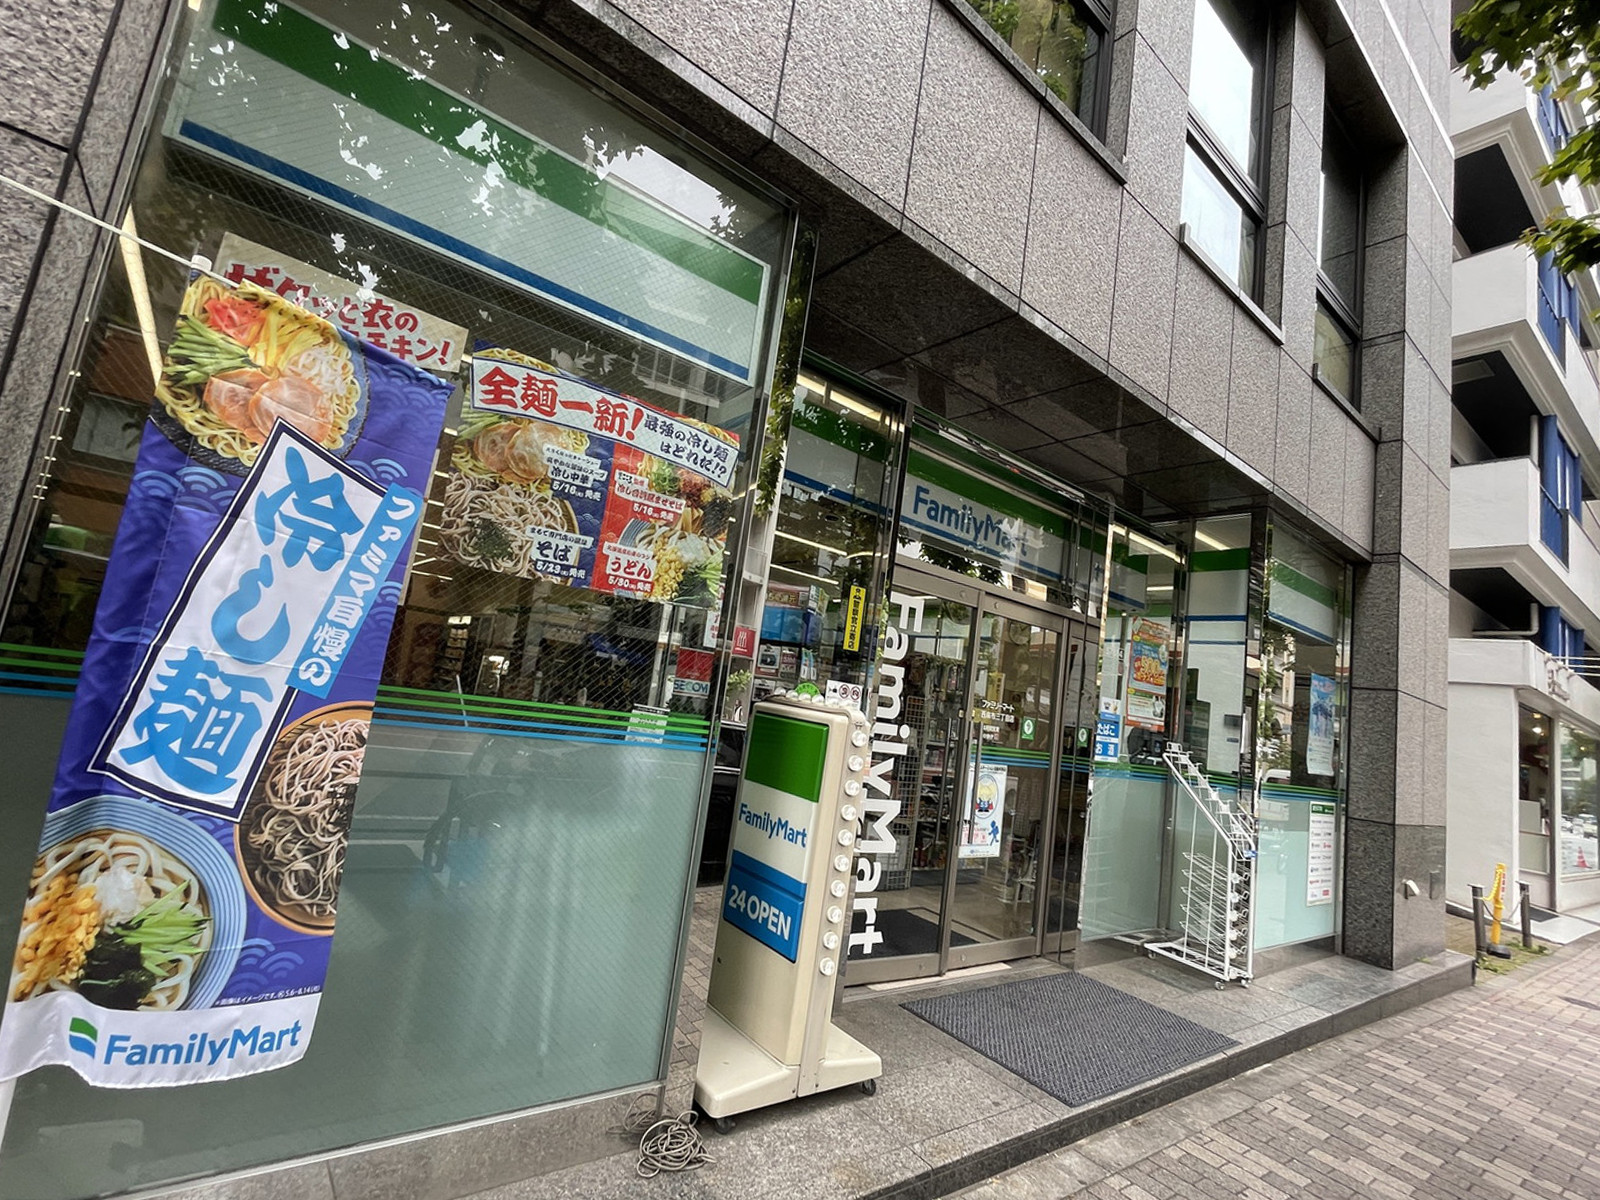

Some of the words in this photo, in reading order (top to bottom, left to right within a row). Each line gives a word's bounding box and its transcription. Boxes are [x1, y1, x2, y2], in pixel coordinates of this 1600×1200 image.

[479, 366, 643, 441] 全麺一新!
[644, 413, 729, 463] 最強の冷し麺
[912, 484, 1029, 557] FamilyMart
[536, 540, 573, 563] そば
[611, 557, 652, 579] うどん
[298, 495, 416, 687] ファミマ自慢の
[118, 445, 365, 795] 冷し麺
[674, 679, 708, 694] SECOM
[848, 590, 925, 956] FamilyMart
[738, 802, 808, 848] FamilyMart
[103, 1018, 302, 1067] FamilyMart
